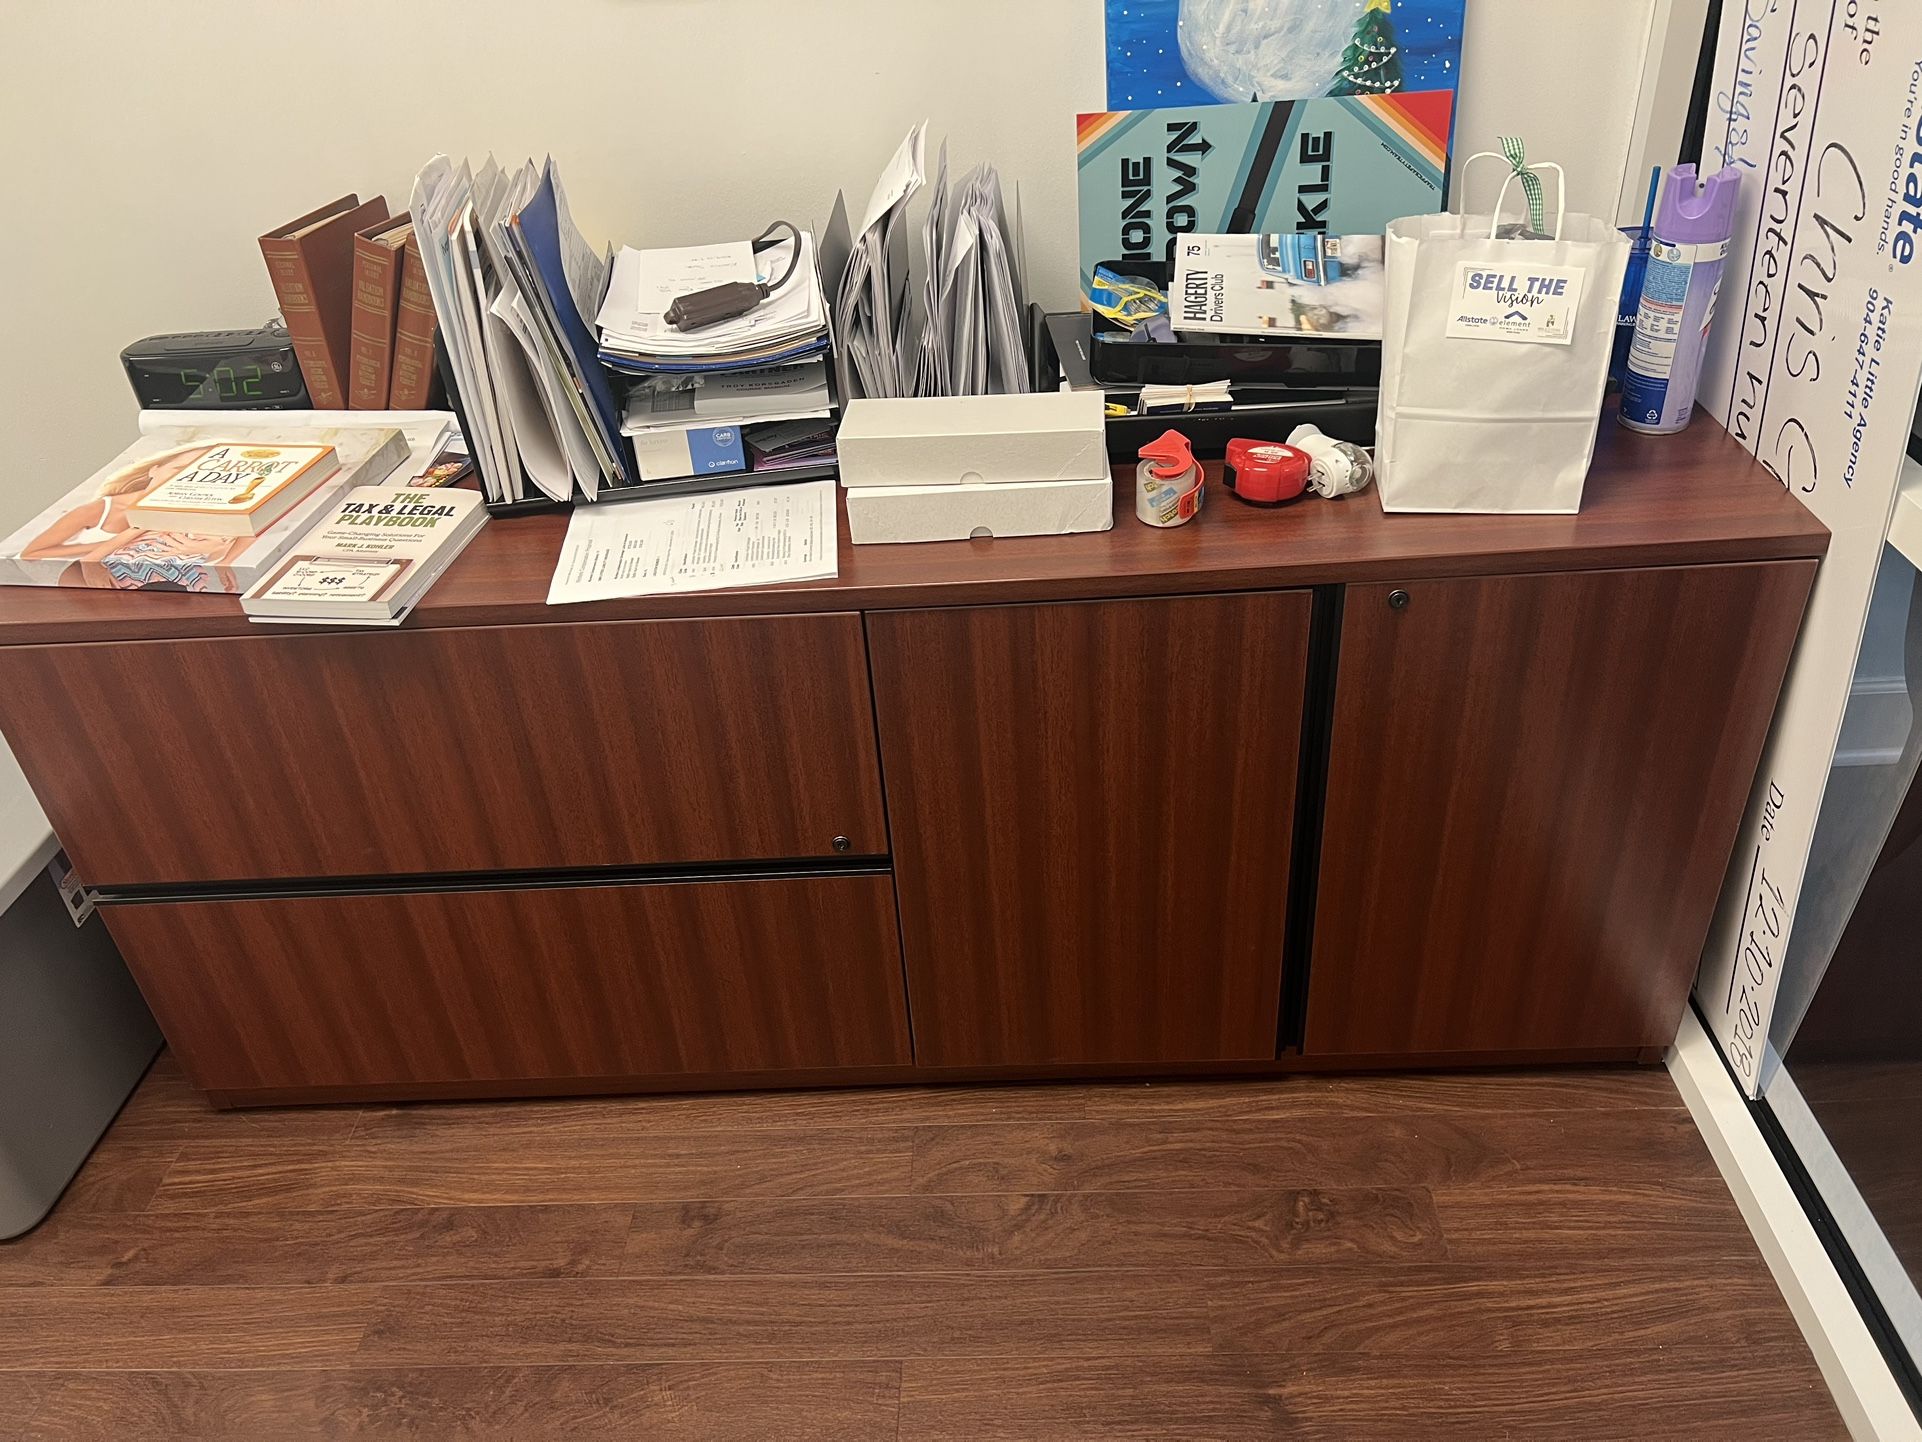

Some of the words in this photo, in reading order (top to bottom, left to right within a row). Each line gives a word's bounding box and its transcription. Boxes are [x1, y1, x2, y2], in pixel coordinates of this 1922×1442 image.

[1843, 0, 1859, 40] of
[1859, 14, 1881, 65] the
[1900, 123, 1912, 141] in
[1296, 131, 1334, 235] KLE
[1889, 144, 1905, 194] good
[1750, 33, 1819, 348] Seventeen
[1876, 197, 1897, 255] hands.
[1187, 245, 1201, 257] 75
[1785, 142, 1867, 382] Chris
[1183, 269, 1208, 322] HAGERTY
[1210, 273, 1224, 292] Club
[1468, 273, 1518, 293] SELL
[1527, 277, 1568, 296] THE
[1210, 292, 1224, 322] Drivers
[1496, 290, 1544, 308] Vision
[1457, 315, 1488, 324] Allstate
[1498, 320, 1531, 329] element
[1873, 296, 1893, 352] Katie
[1844, 287, 1879, 419] 904-647-4111
[1861, 357, 1880, 409] Little
[208, 448, 230, 459] A
[1843, 412, 1867, 489] Agency
[176, 471, 199, 483] A
[197, 472, 251, 484] DAY
[197, 459, 299, 473] CARROT
[341, 503, 380, 514] TAX
[380, 504, 395, 515] &
[396, 505, 456, 517] LEGAL
[390, 493, 430, 504] THE
[335, 515, 440, 528] PLAYBOOK
[1761, 779, 1785, 842] Date
